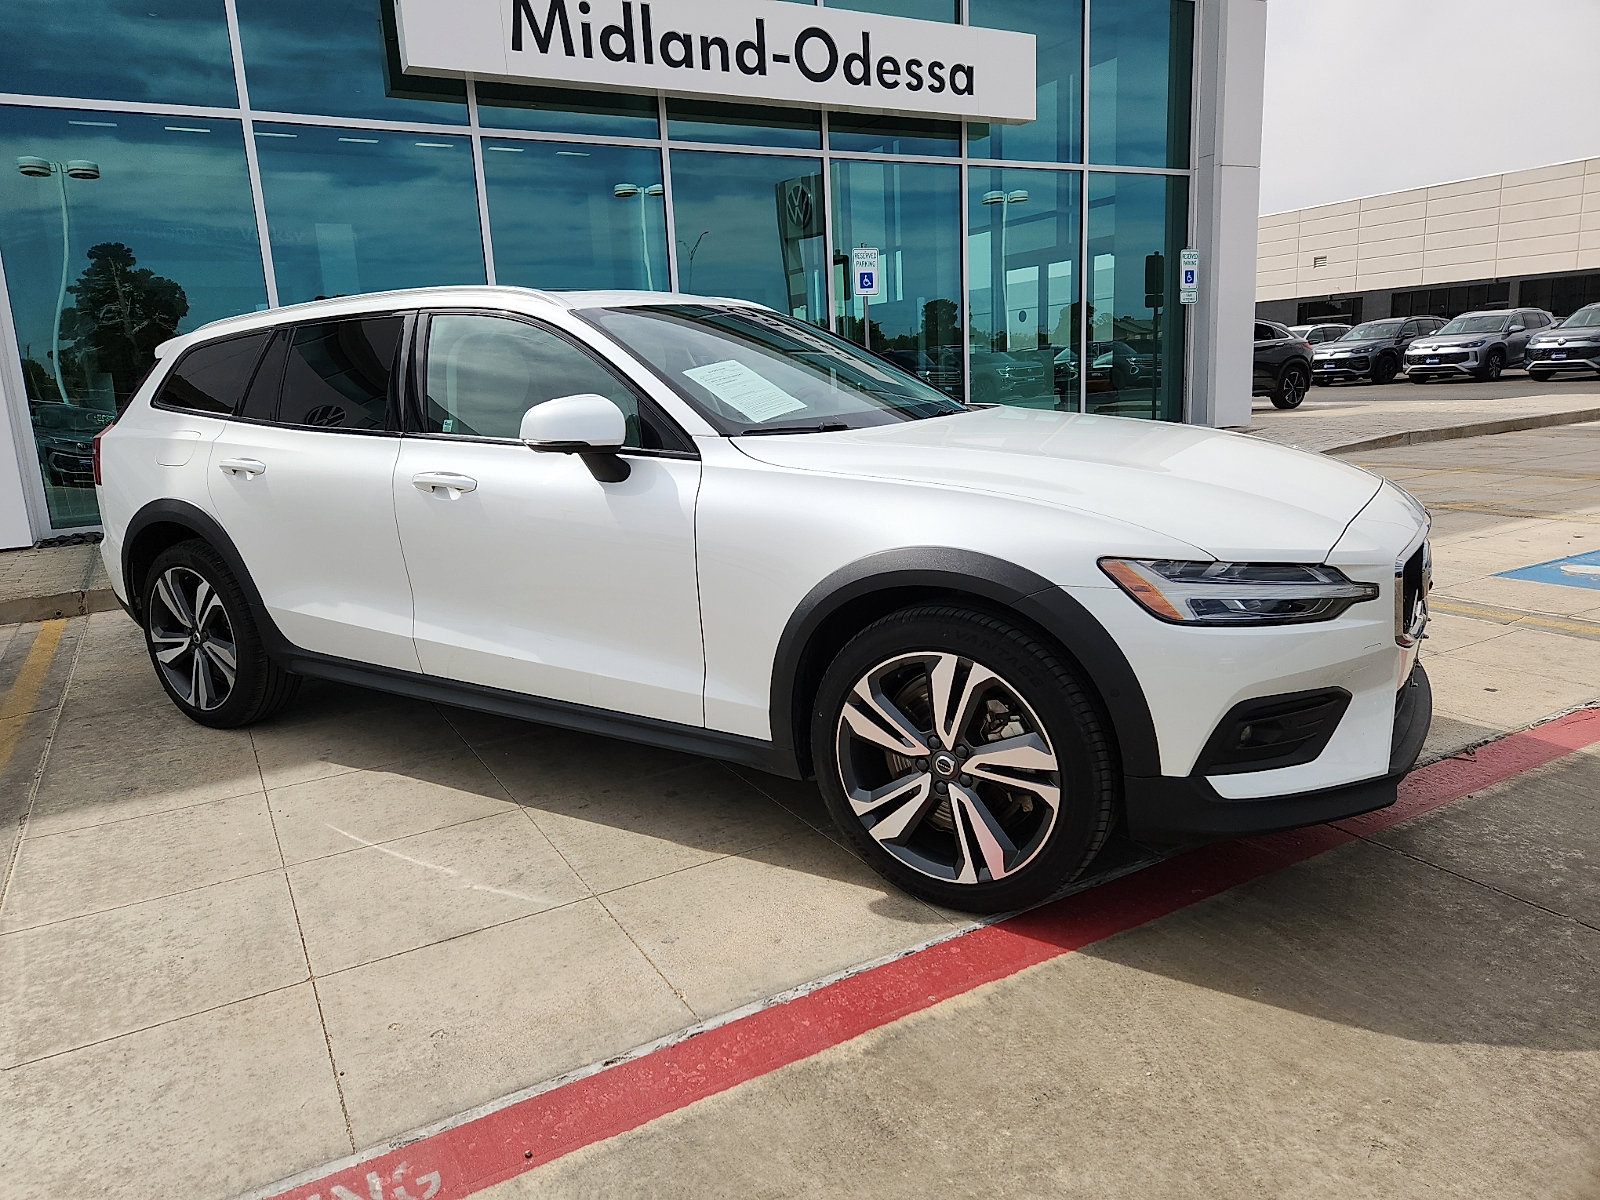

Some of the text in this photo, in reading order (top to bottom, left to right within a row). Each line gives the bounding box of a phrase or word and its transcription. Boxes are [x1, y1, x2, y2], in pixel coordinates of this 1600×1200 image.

[510, 0, 975, 97] Midland-Odessa
[854, 252, 877, 260] RESERVED
[855, 260, 876, 268] PARKING
